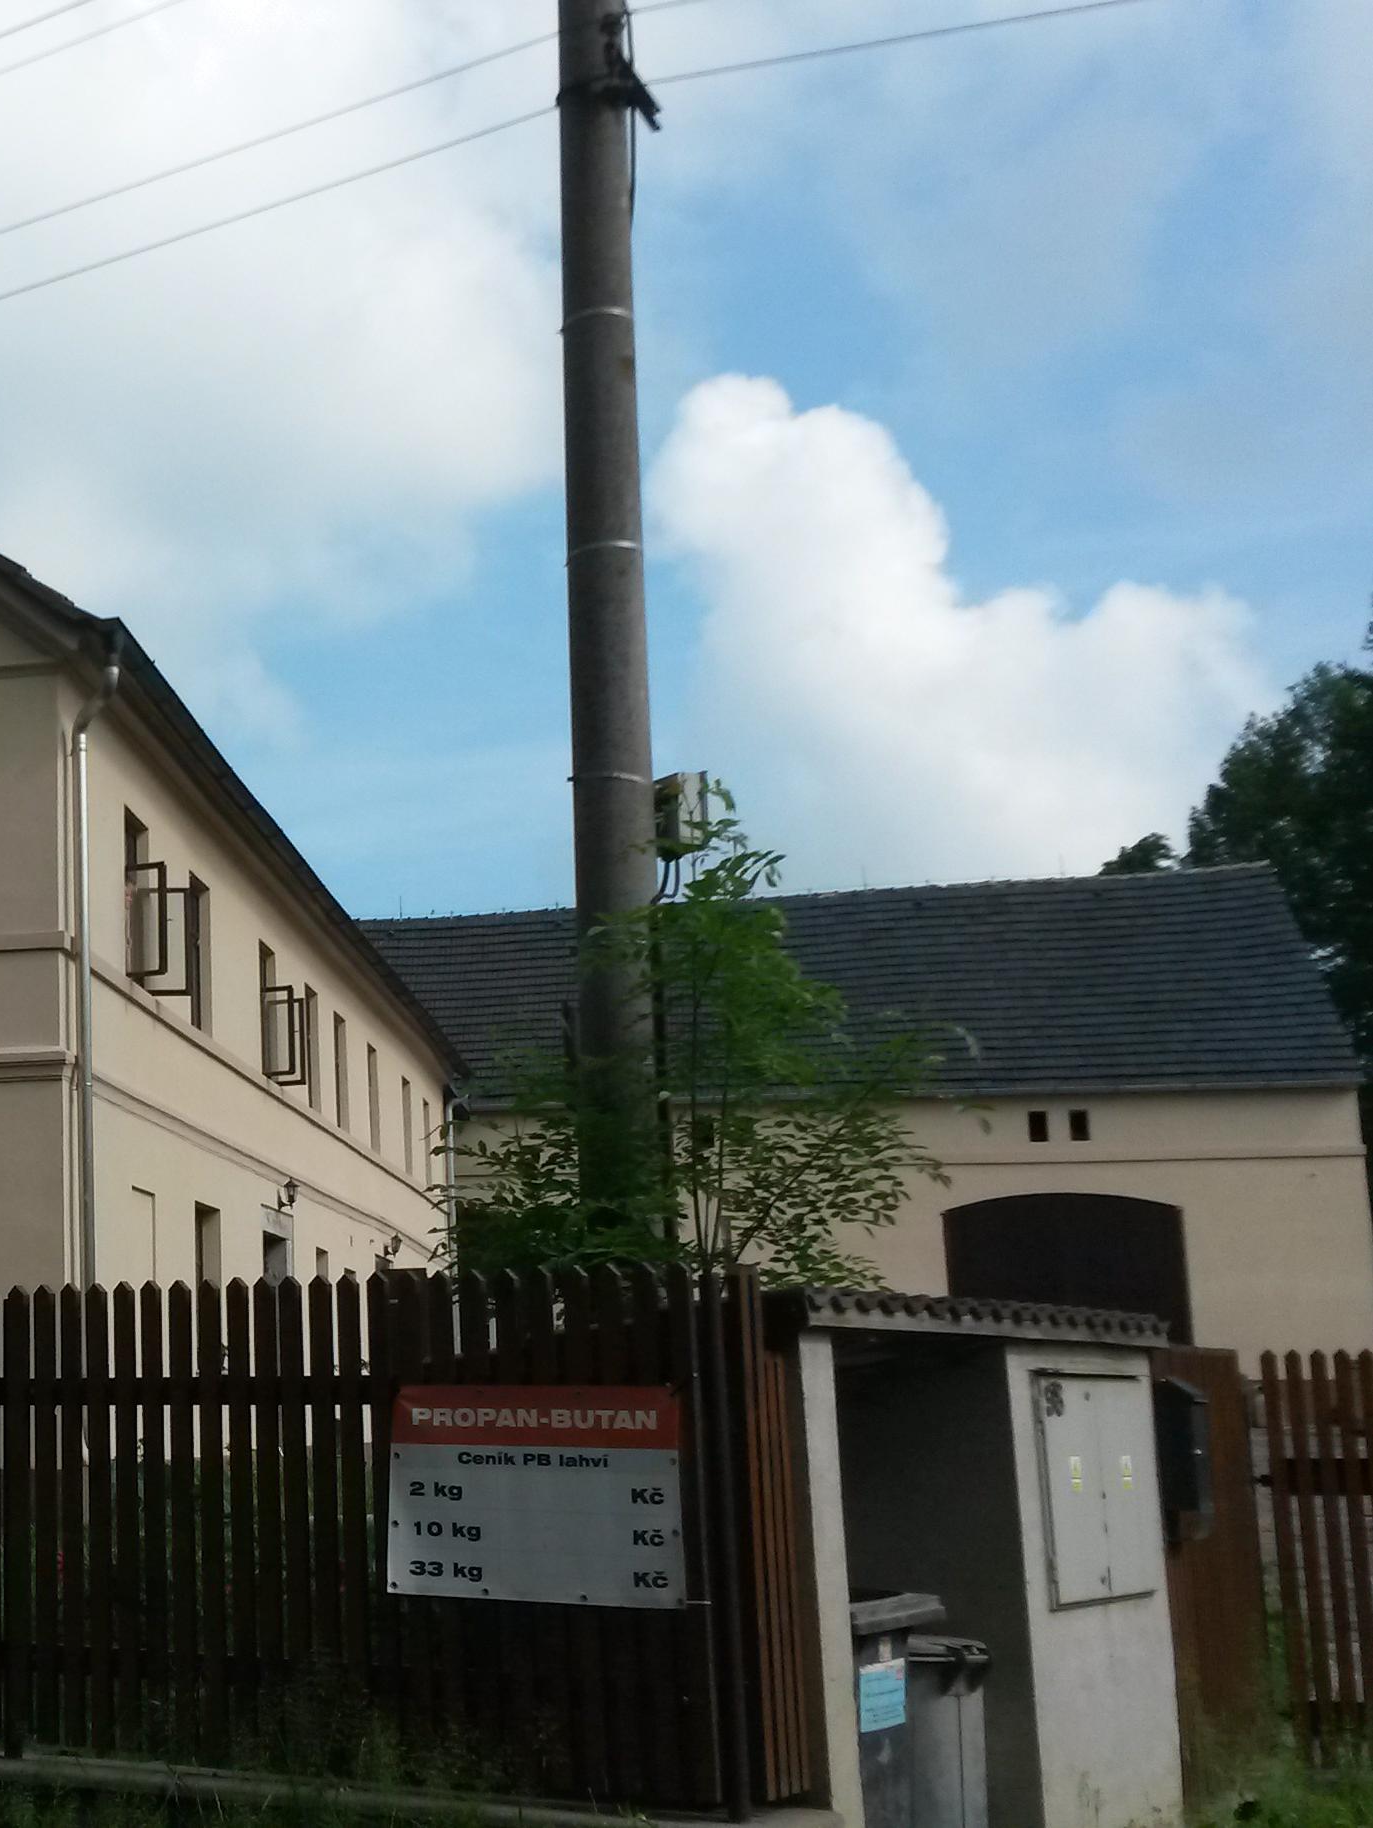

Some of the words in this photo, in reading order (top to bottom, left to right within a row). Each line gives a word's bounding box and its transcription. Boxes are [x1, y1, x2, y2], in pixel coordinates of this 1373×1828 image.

[411, 1407, 657, 1430] PROPAN-BUTAN
[458, 1451, 515, 1465] Ceník
[523, 1453, 551, 1466] PB
[560, 1454, 608, 1468] lahví
[409, 1482, 425, 1497] 2
[434, 1482, 463, 1500] kg
[631, 1487, 664, 1504] Kč
[414, 1521, 442, 1536] 10
[452, 1522, 481, 1542] kg
[633, 1529, 664, 1546] Kč
[409, 1561, 443, 1576] 33
[453, 1563, 482, 1582] kg
[634, 1571, 668, 1588] Kč
